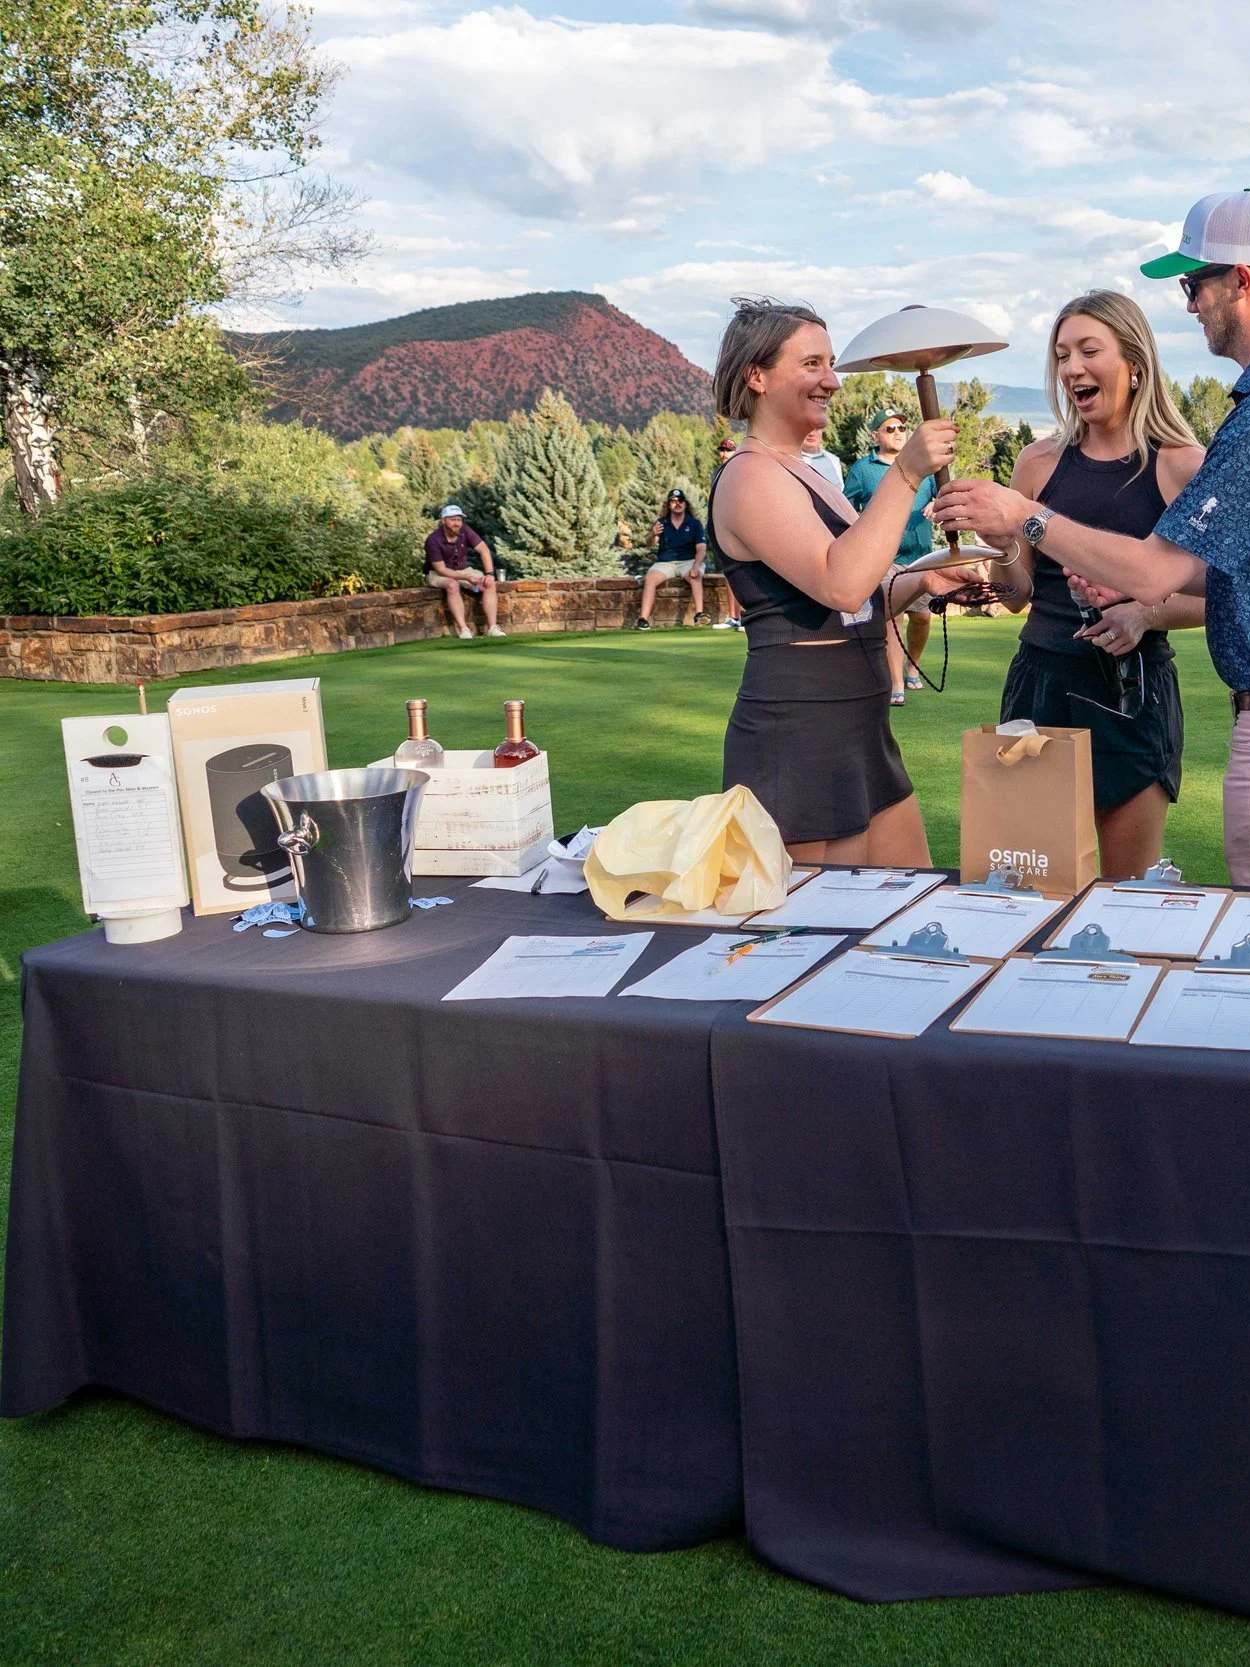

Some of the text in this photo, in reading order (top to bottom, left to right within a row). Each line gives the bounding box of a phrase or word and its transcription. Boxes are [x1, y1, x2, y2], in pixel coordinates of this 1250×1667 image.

[175, 705, 217, 716] SONOS
[989, 848, 1048, 868] osmia
[1019, 866, 1048, 877] CARE
